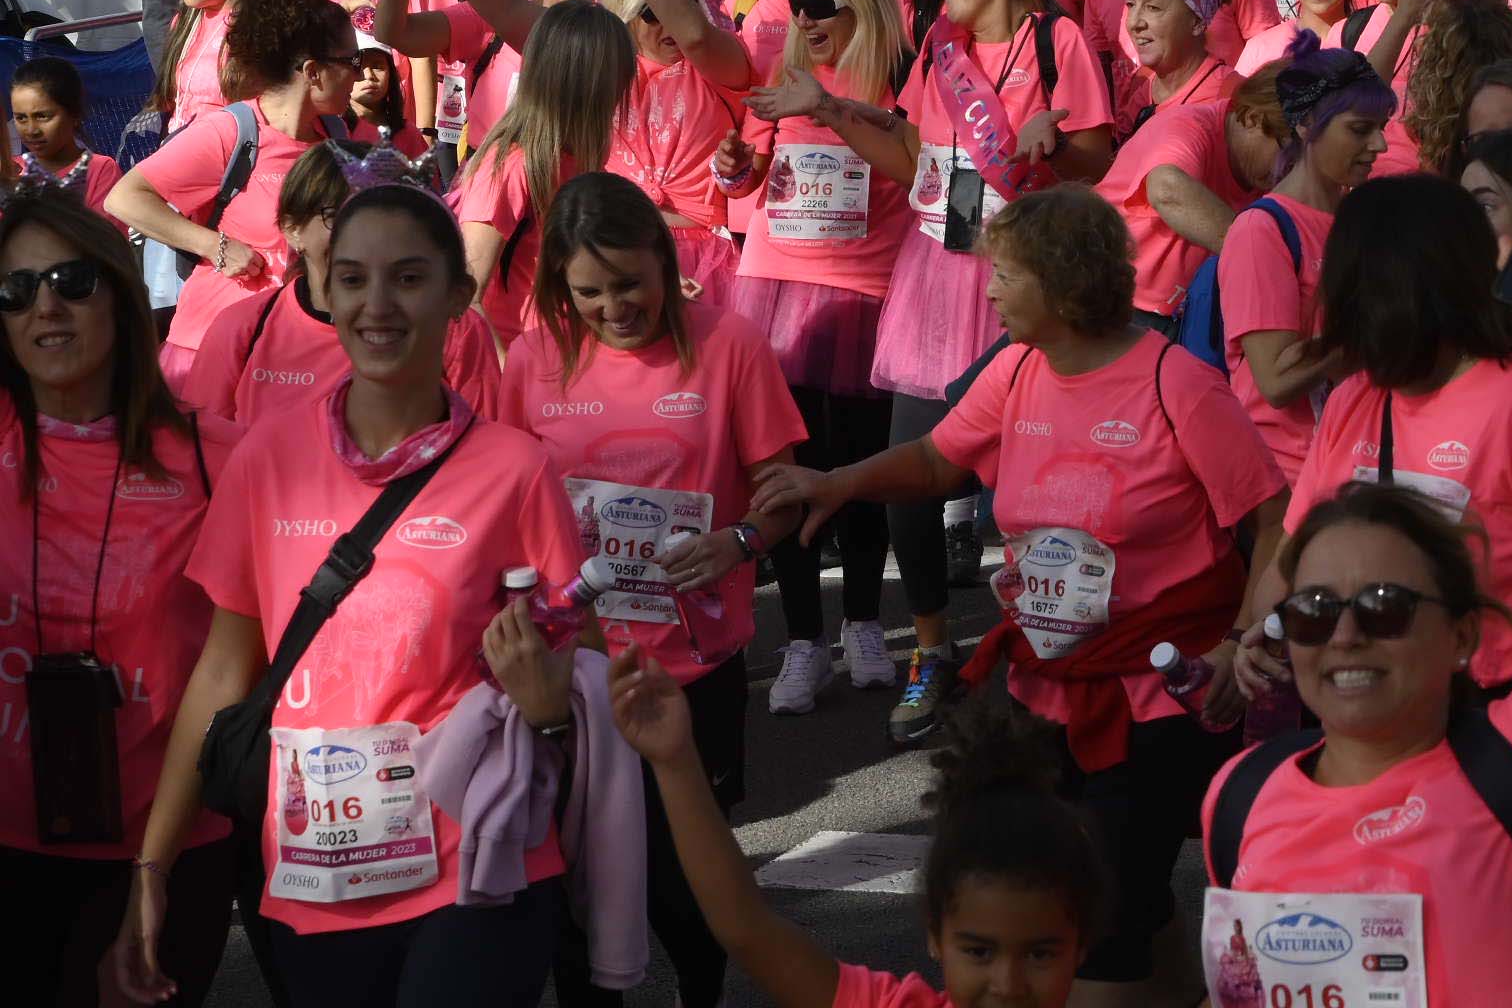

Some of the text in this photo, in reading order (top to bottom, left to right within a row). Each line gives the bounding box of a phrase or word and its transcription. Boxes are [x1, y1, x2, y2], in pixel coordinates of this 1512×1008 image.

[797, 160, 838, 170] ASTURIANA
[800, 182, 833, 196] 016
[253, 368, 314, 385] OYSHO
[542, 401, 604, 417] OYSHO
[1094, 429, 1137, 444] ASTURIANA
[605, 506, 661, 523] ASTURIANA
[401, 527, 462, 542] ASTURIANA
[605, 538, 656, 558] 016
[622, 582, 665, 592] LA MUJER
[1028, 576, 1066, 597] 016
[1031, 601, 1059, 614] 16757
[374, 744, 410, 756] SUMA
[312, 796, 363, 822] 016
[316, 829, 359, 846] 20023
[291, 844, 416, 863] CARRERA DE LA MUJER 2023
[282, 872, 320, 889] OYSHO
[364, 867, 424, 883] Santander
[1361, 926, 1405, 938] SUMA
[1262, 932, 1346, 952] ASTURIANA
[1271, 983, 1345, 1008] 016
